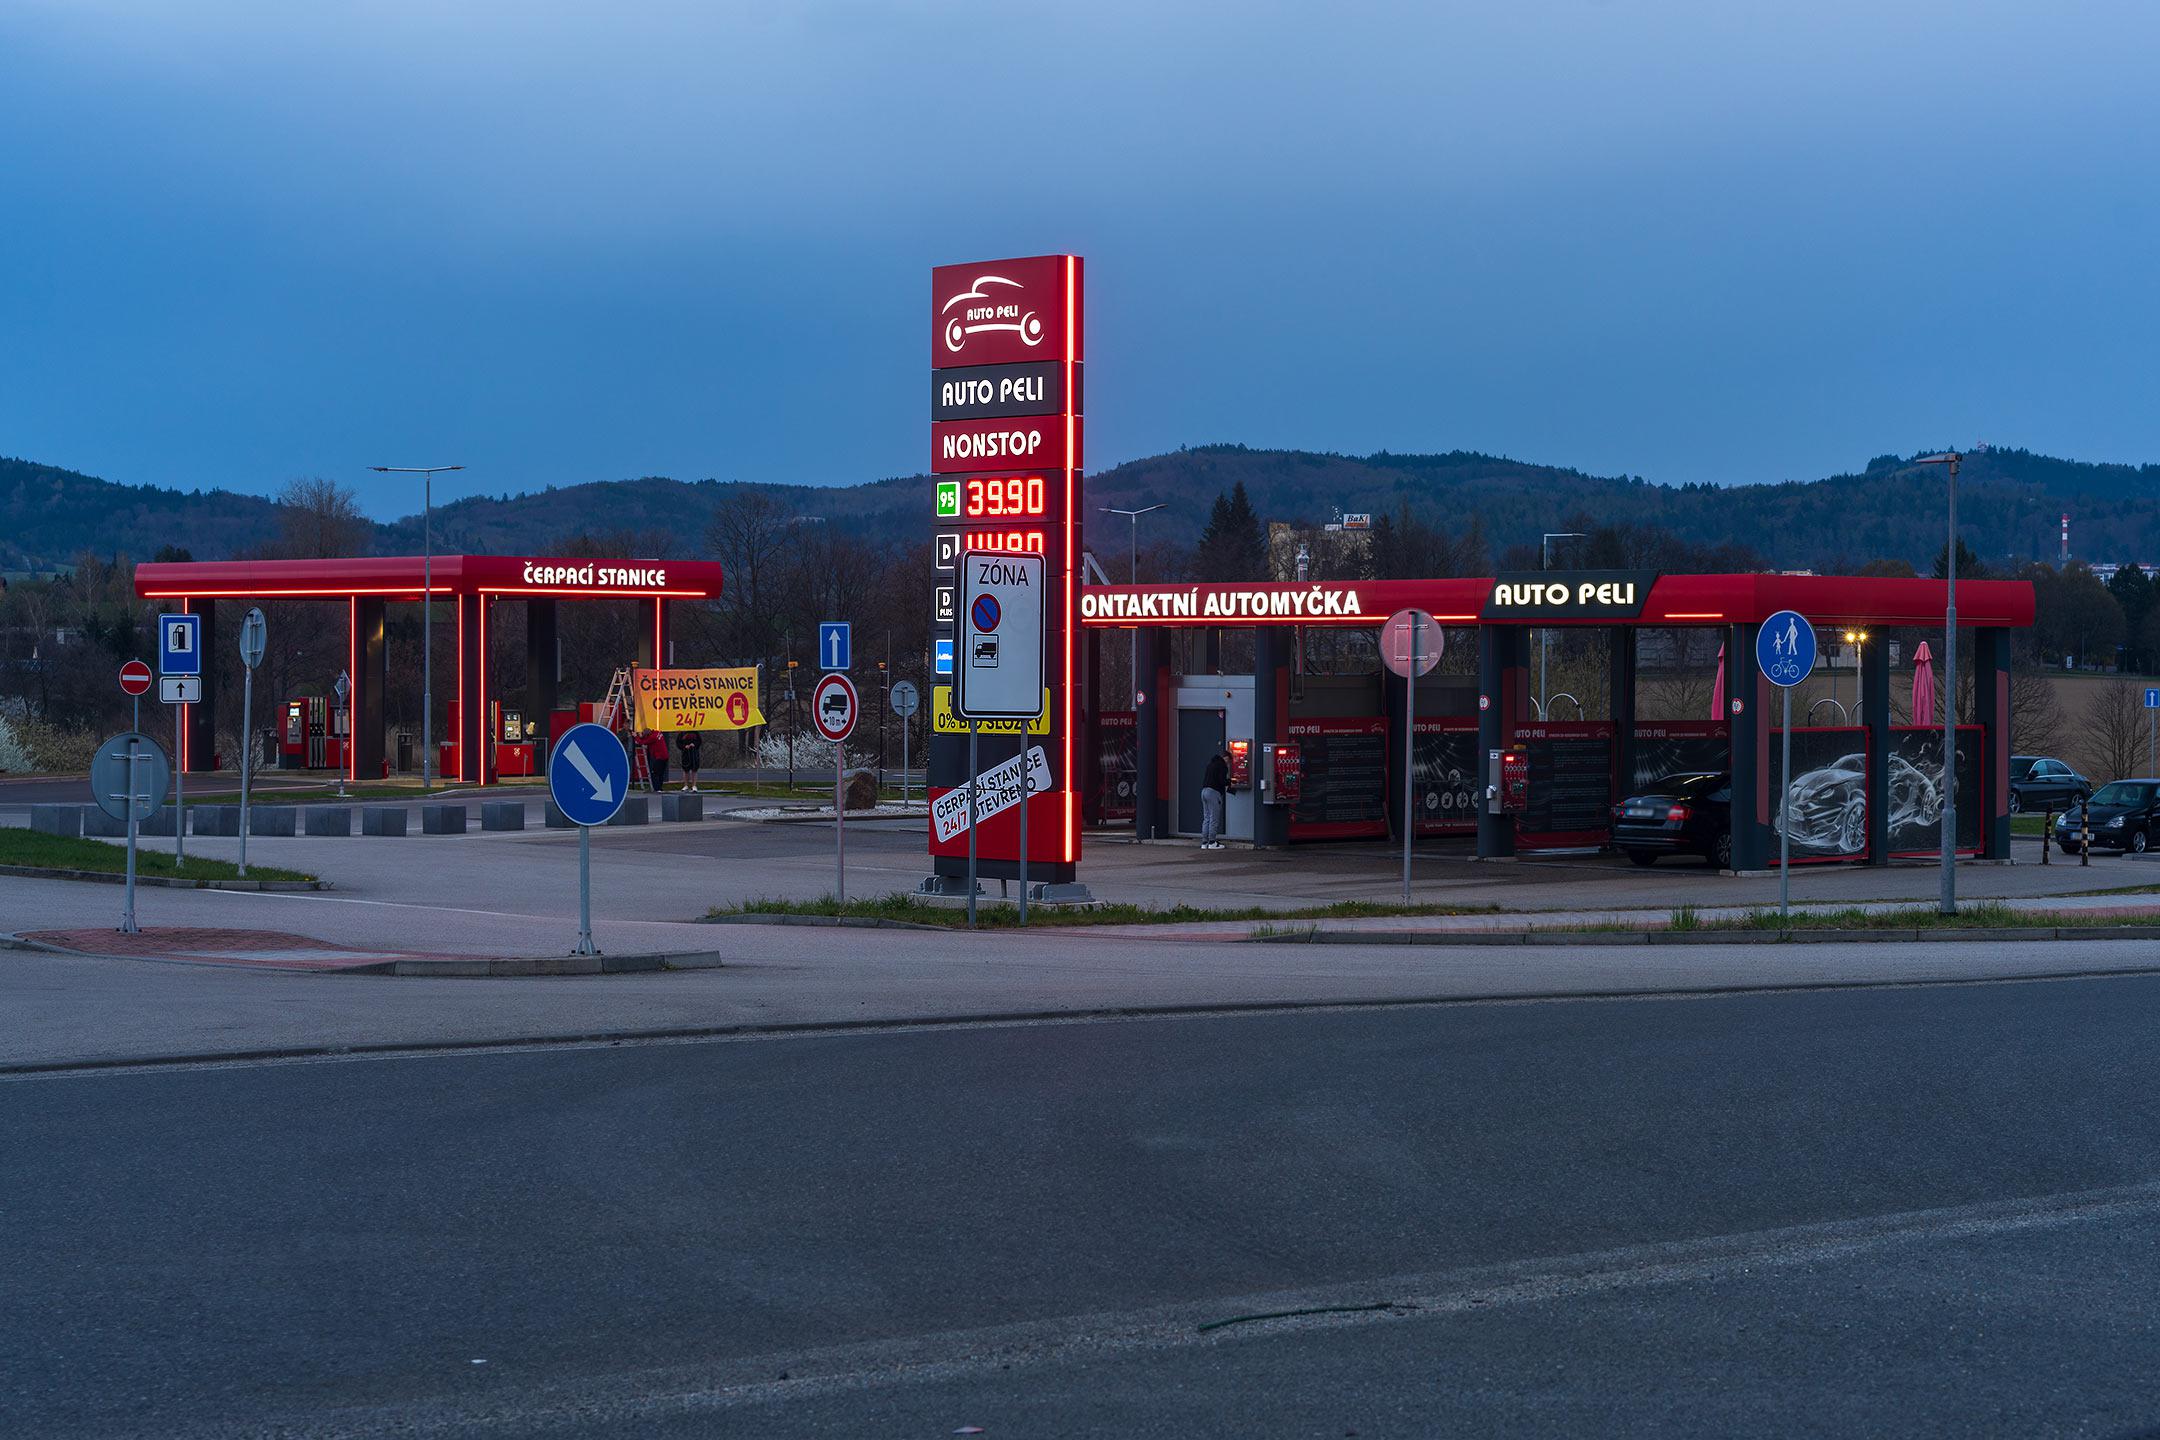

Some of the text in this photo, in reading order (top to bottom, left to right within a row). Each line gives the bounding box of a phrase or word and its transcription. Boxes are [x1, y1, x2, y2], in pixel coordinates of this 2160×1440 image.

[966, 304, 1019, 321] AUTO PELI
[942, 376, 1044, 407] AUTO PELI
[943, 430, 1042, 459] NONSTOP
[940, 479, 1043, 515] 95 39.90
[942, 543, 952, 560] D
[523, 561, 666, 586] ČERPACÍ STANICE
[978, 558, 1030, 587] ZÓNA
[942, 592, 951, 606] D
[1081, 585, 1362, 617] ONTAKTNÍ AUTOMYČKA
[1495, 582, 1634, 605] AUTO PELI
[640, 675, 753, 691] ČERPACÍ STANICE
[652, 693, 724, 710] OTEVŘENO
[675, 711, 706, 728] 24/7
[1428, 723, 1441, 732] PELI
[1307, 725, 1321, 734] PELI
[1532, 729, 1546, 738] PELI
[1653, 728, 1667, 737] PELI
[943, 810, 967, 836] 24/7
